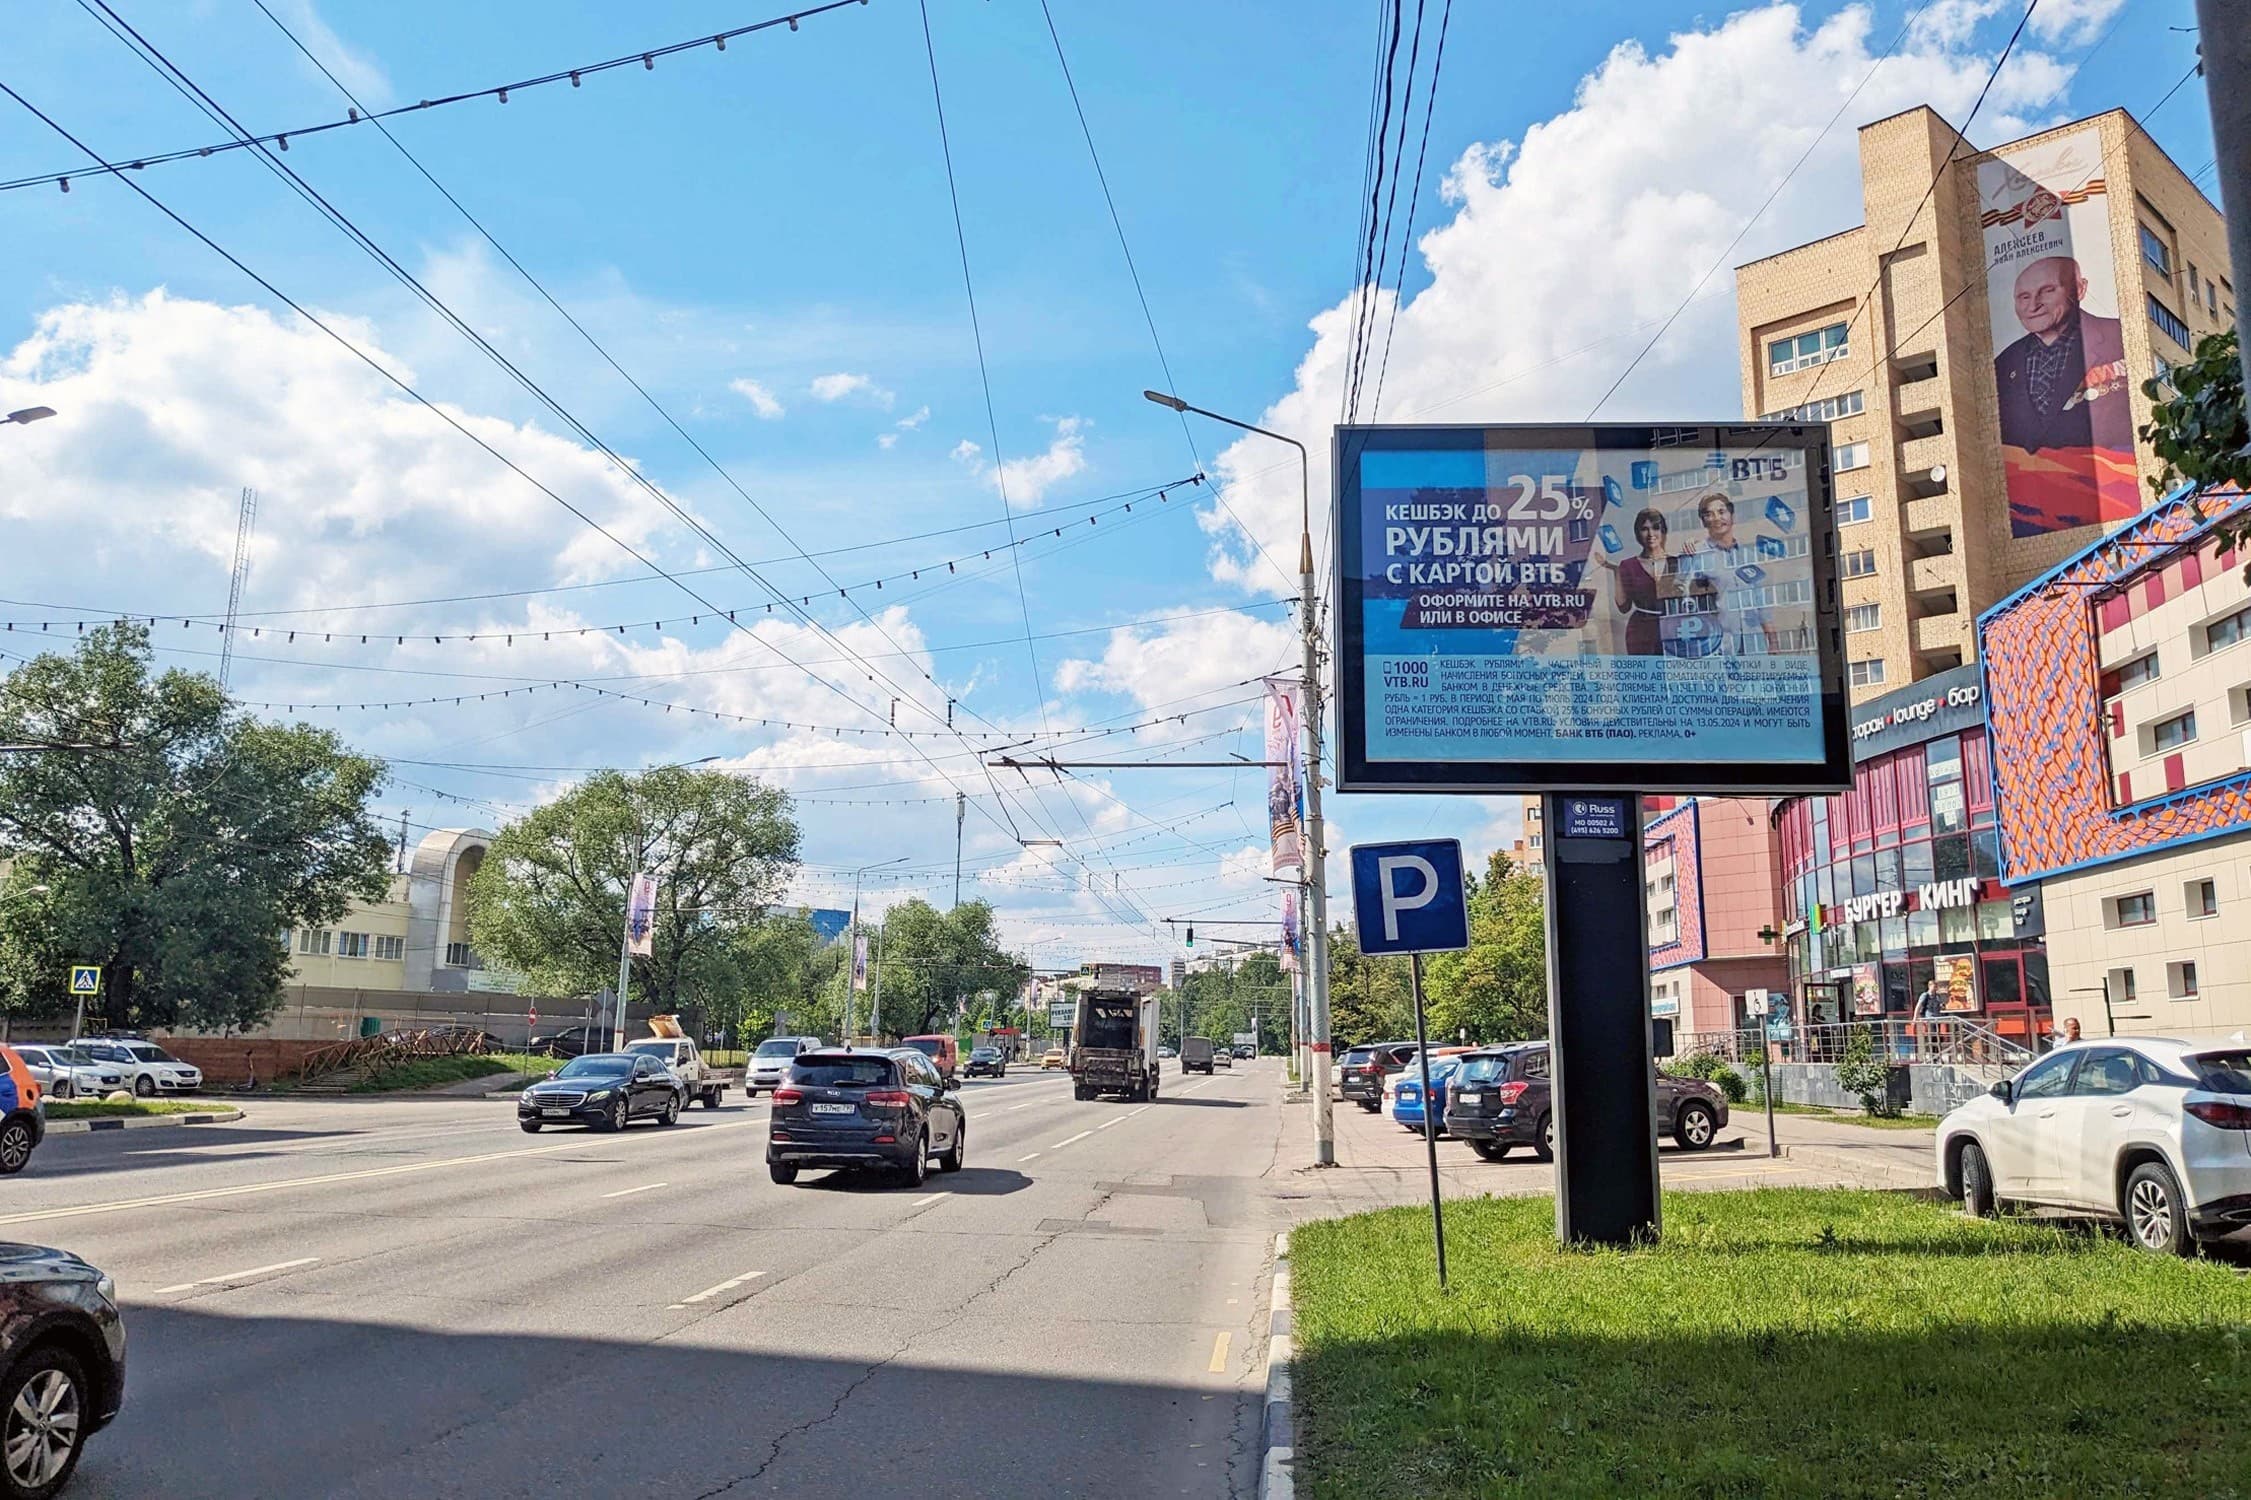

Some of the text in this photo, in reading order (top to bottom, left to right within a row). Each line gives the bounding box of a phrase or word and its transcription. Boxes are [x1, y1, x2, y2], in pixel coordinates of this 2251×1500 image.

[1993, 231, 2046, 256] АЛЕКСЕЕВ
[2015, 238, 2064, 260] АЛЕКСЕЕВИЧ
[1732, 458, 1788, 481] ВТБ
[1385, 474, 1594, 523] КЕШБЭК ДО 25%
[1385, 526, 1564, 556] РУБЛЯМИ
[1386, 557, 1566, 584] С КАРТОЙ ВТБ
[1419, 593, 1585, 608] ОФОРМИТЕ НА VTB.RU
[1419, 609, 1522, 624] ИЛИ В ОФИСЕ
[1394, 661, 1429, 675] 1000
[1440, 660, 1476, 668] КЕШБЭК
[1484, 660, 1525, 668] РУБЛЯМИ
[1611, 660, 1647, 669] ВОЗВРАТ
[1655, 661, 1710, 669] СТОИМОСТИ
[1770, 661, 1776, 669] В
[1384, 676, 1429, 688] VTB.RU
[1440, 672, 1498, 680] НАЧИСЛЕНИЯ
[1501, 672, 1548, 680] БОНУСНЫХ
[1589, 672, 1647, 680] ЕЖЕМЕСЯЧНО
[1728, 672, 1809, 681] КОНВЕРТИРУЕМЫХ
[1441, 683, 1478, 691] БАНКОМ
[1482, 683, 1487, 691] В
[1491, 683, 1539, 693] ДЕНЕЖНЫЕ
[1593, 683, 1657, 692] ЗАЧИСЛЯЕМЫЕ
[1718, 684, 1746, 692] КУРСУ
[1384, 694, 1410, 702] РУБЛЬ
[1422, 694, 1426, 702] 1
[1430, 694, 1447, 702] РУБ.
[1450, 694, 1456, 702] В
[1459, 694, 1494, 704] ПЕРИОД
[1497, 694, 1502, 703] С
[1506, 694, 1526, 703] МАЯ
[1529, 694, 1542, 703] ПО
[1573, 694, 1594, 703] 2024
[1596, 695, 1618, 704] ГОДА
[1622, 695, 1668, 703] КЛИЕНТАМ
[1671, 695, 1721, 705] ДОСТУПНА
[1721, 695, 1739, 705] ДЛЯ
[1947, 685, 1979, 707] бар
[1384, 704, 1810, 716] ОДНА КАТЕГОРИЯ КЕШБЭКА СО СТАВКОЙ 25% БОНУСНЫХ РУБЛЕЙ ОТ СУММЫ ОПЕРАЦИЙ. ИМЕЮТСЯ
[1893, 698, 1936, 726] lounge
[1385, 717, 1448, 725] ОГРАНИЧЕНИЯ.
[1452, 717, 1503, 727] ПОДРОБНЕЕ
[1506, 717, 1519, 726] НА
[1559, 717, 1599, 726] УСЛОВИЯ
[1602, 716, 1677, 728] ДЕЙСТВИТЕЛЬНЫ
[1680, 718, 1693, 726] НА
[1696, 718, 1740, 727] 13.05.2024
[1743, 718, 1750, 727] И
[1754, 718, 1783, 727] МОГУТ
[1787, 718, 1811, 727] БЫТЬ
[1385, 727, 1697, 738] ИЗМЕНЕНЫ БАНКОМ В ЛЮБОЙ МОМЕНТ. БАНК ВТБ (ПАО). РЕКЛАМА. 0+
[1589, 804, 1615, 814] Russ
[1378, 855, 1438, 941] P
[1843, 877, 1979, 924] БУРГЕР КИНГ
